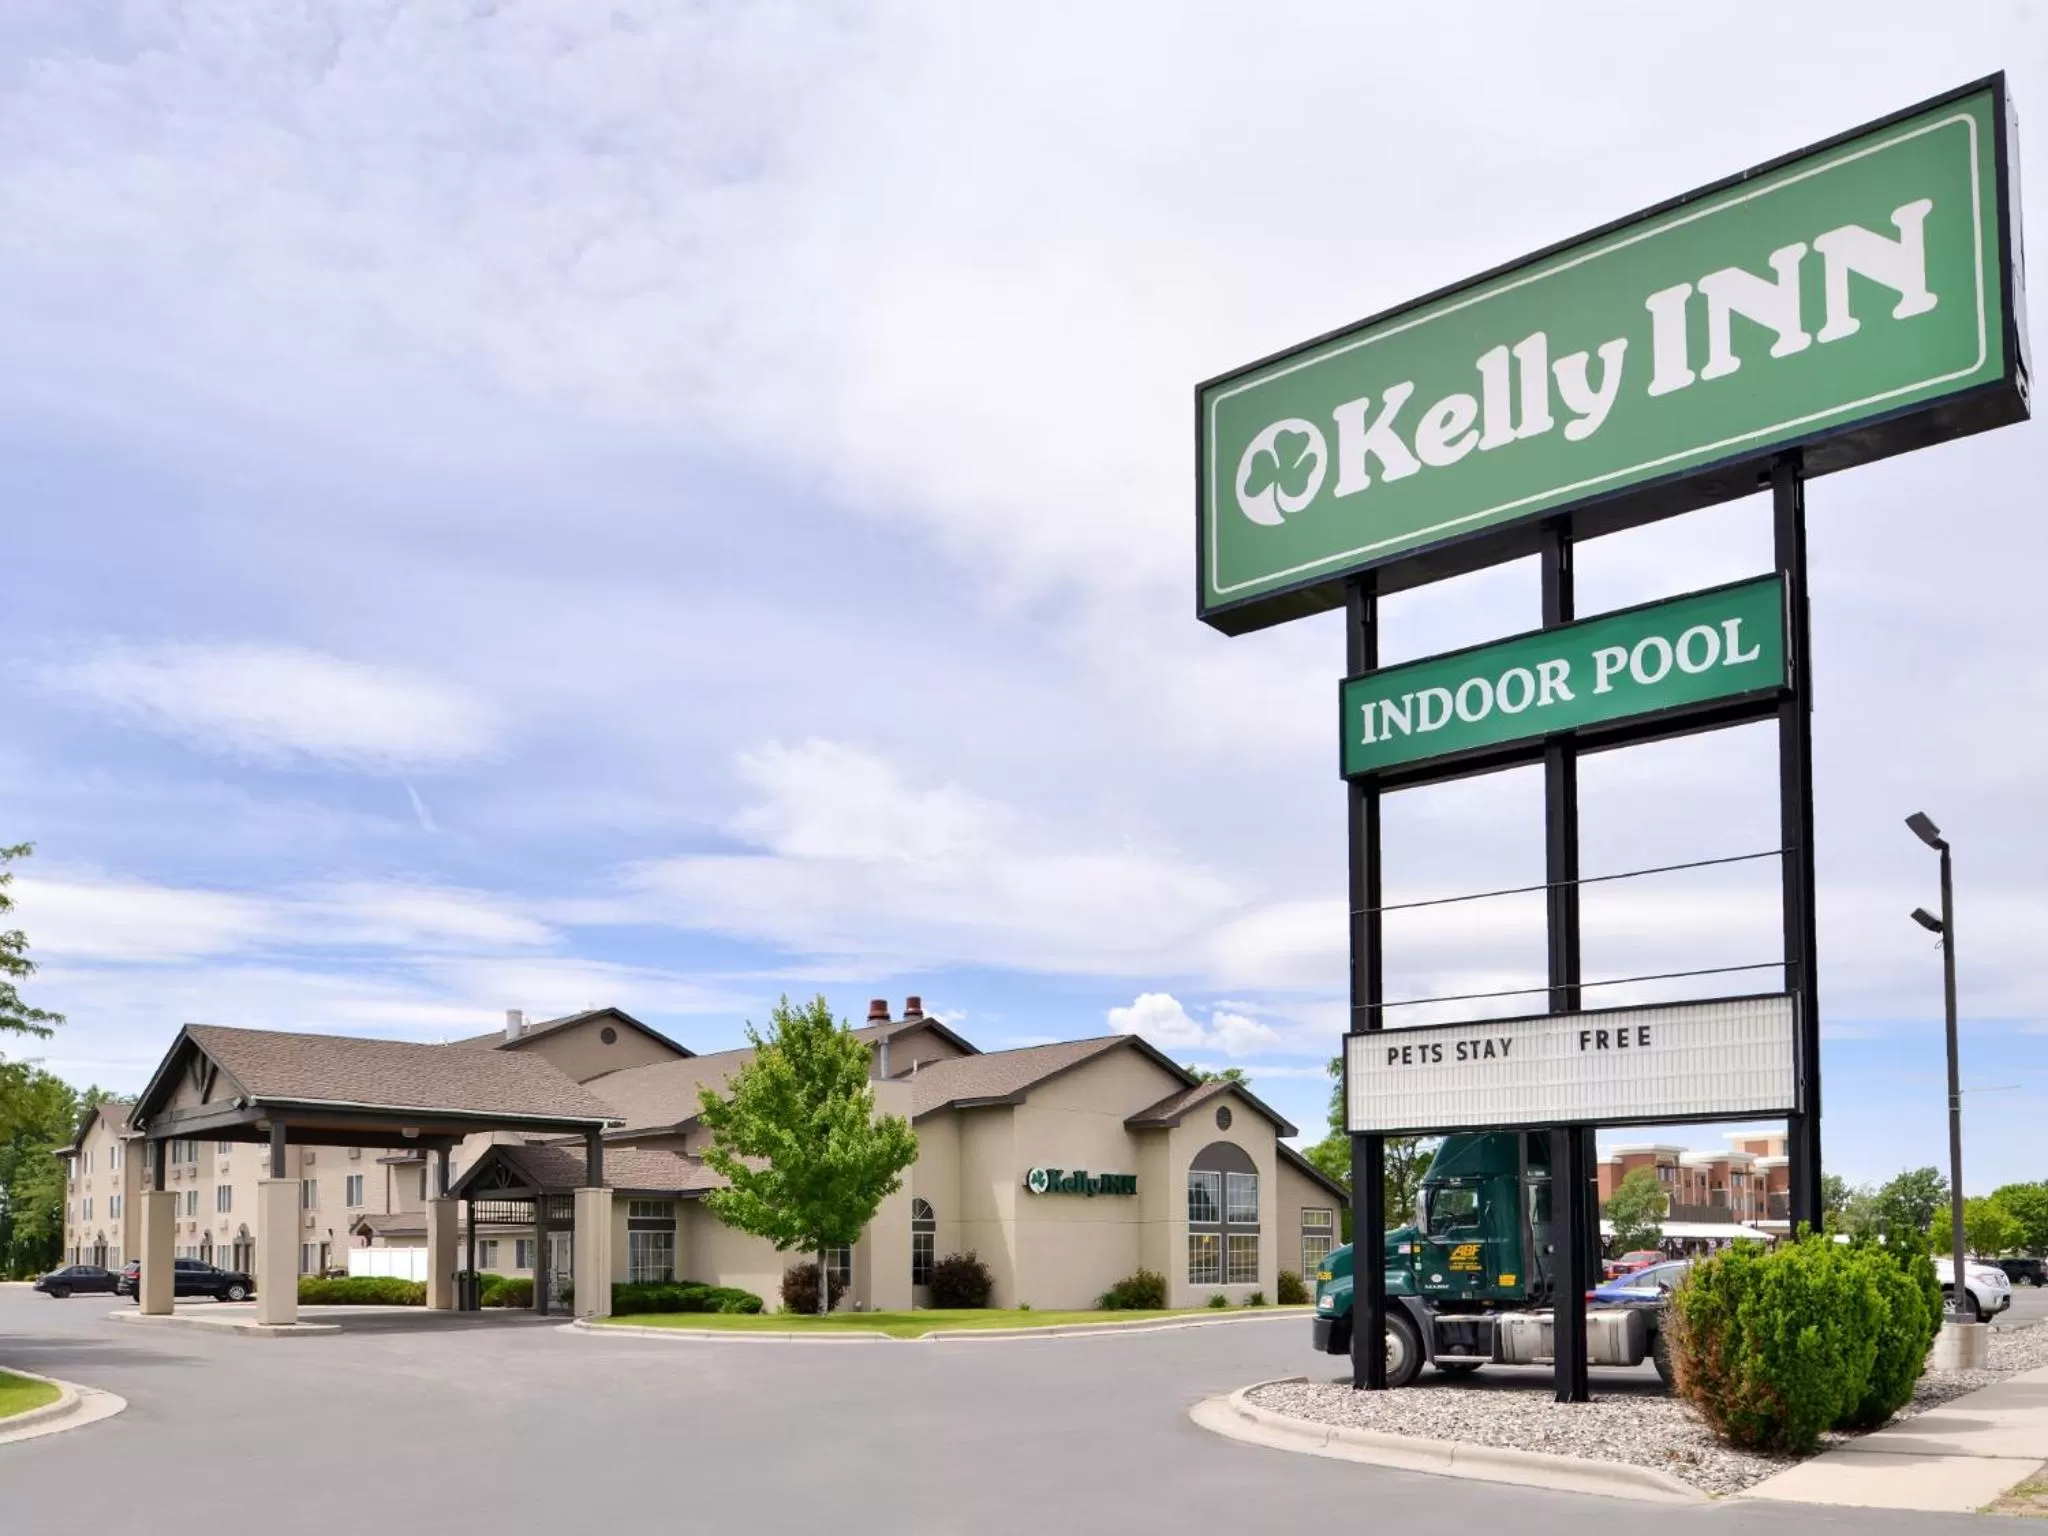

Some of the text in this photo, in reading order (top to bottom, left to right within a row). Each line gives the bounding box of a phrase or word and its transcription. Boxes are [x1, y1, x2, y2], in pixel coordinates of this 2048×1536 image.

[1333, 200, 1936, 497] Kelly INN
[1362, 618, 1760, 744] INDOOR POOL
[1387, 1026, 1651, 1065] PETS STAY FREE
[1046, 1169, 1137, 1197] Kelly INN
[1452, 1244, 1481, 1257] ABF
